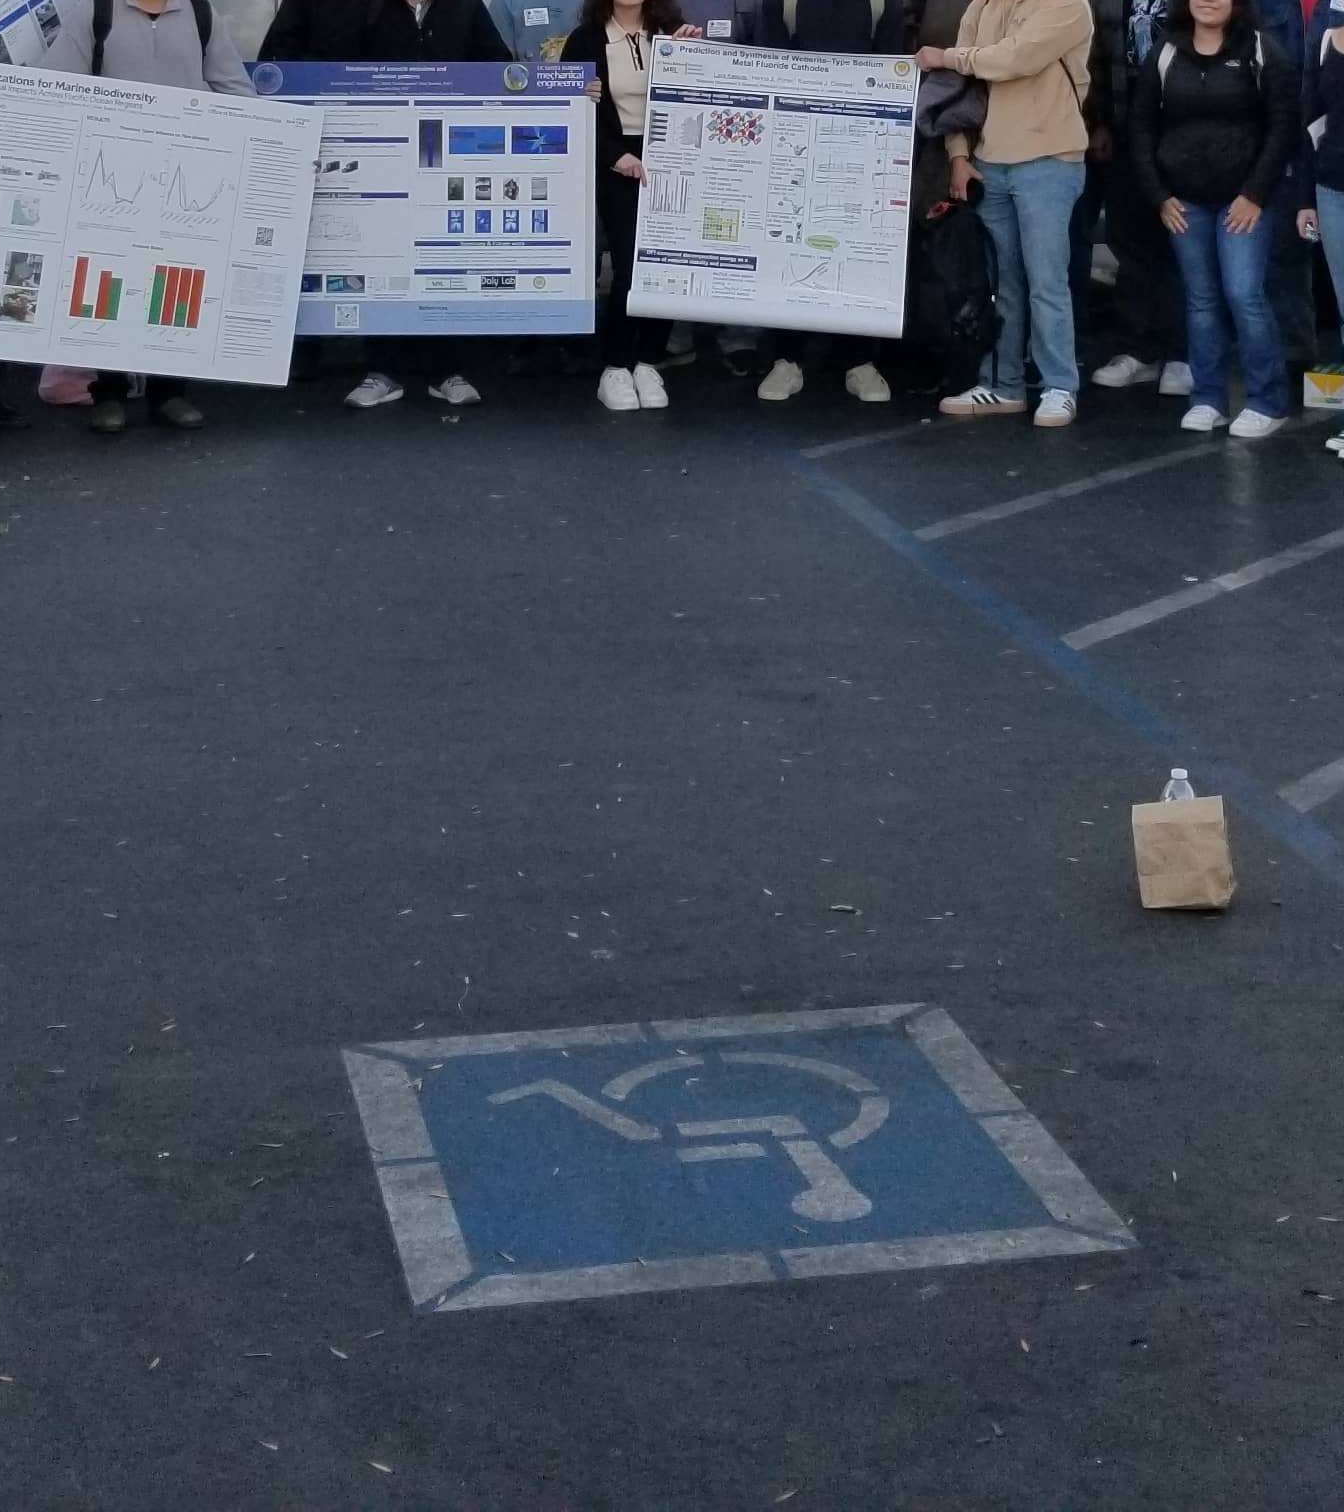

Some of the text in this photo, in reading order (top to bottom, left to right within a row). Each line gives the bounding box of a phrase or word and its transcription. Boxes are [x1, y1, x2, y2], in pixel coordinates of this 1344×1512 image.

[679, 45, 721, 57] Prediction
[722, 50, 739, 58] and
[732, 59, 754, 68] Metal
[791, 63, 829, 73] Cathodes
[536, 71, 584, 80] mechanical
[37, 77, 53, 88] for
[55, 80, 93, 94] Marine
[536, 80, 584, 89] engineering
